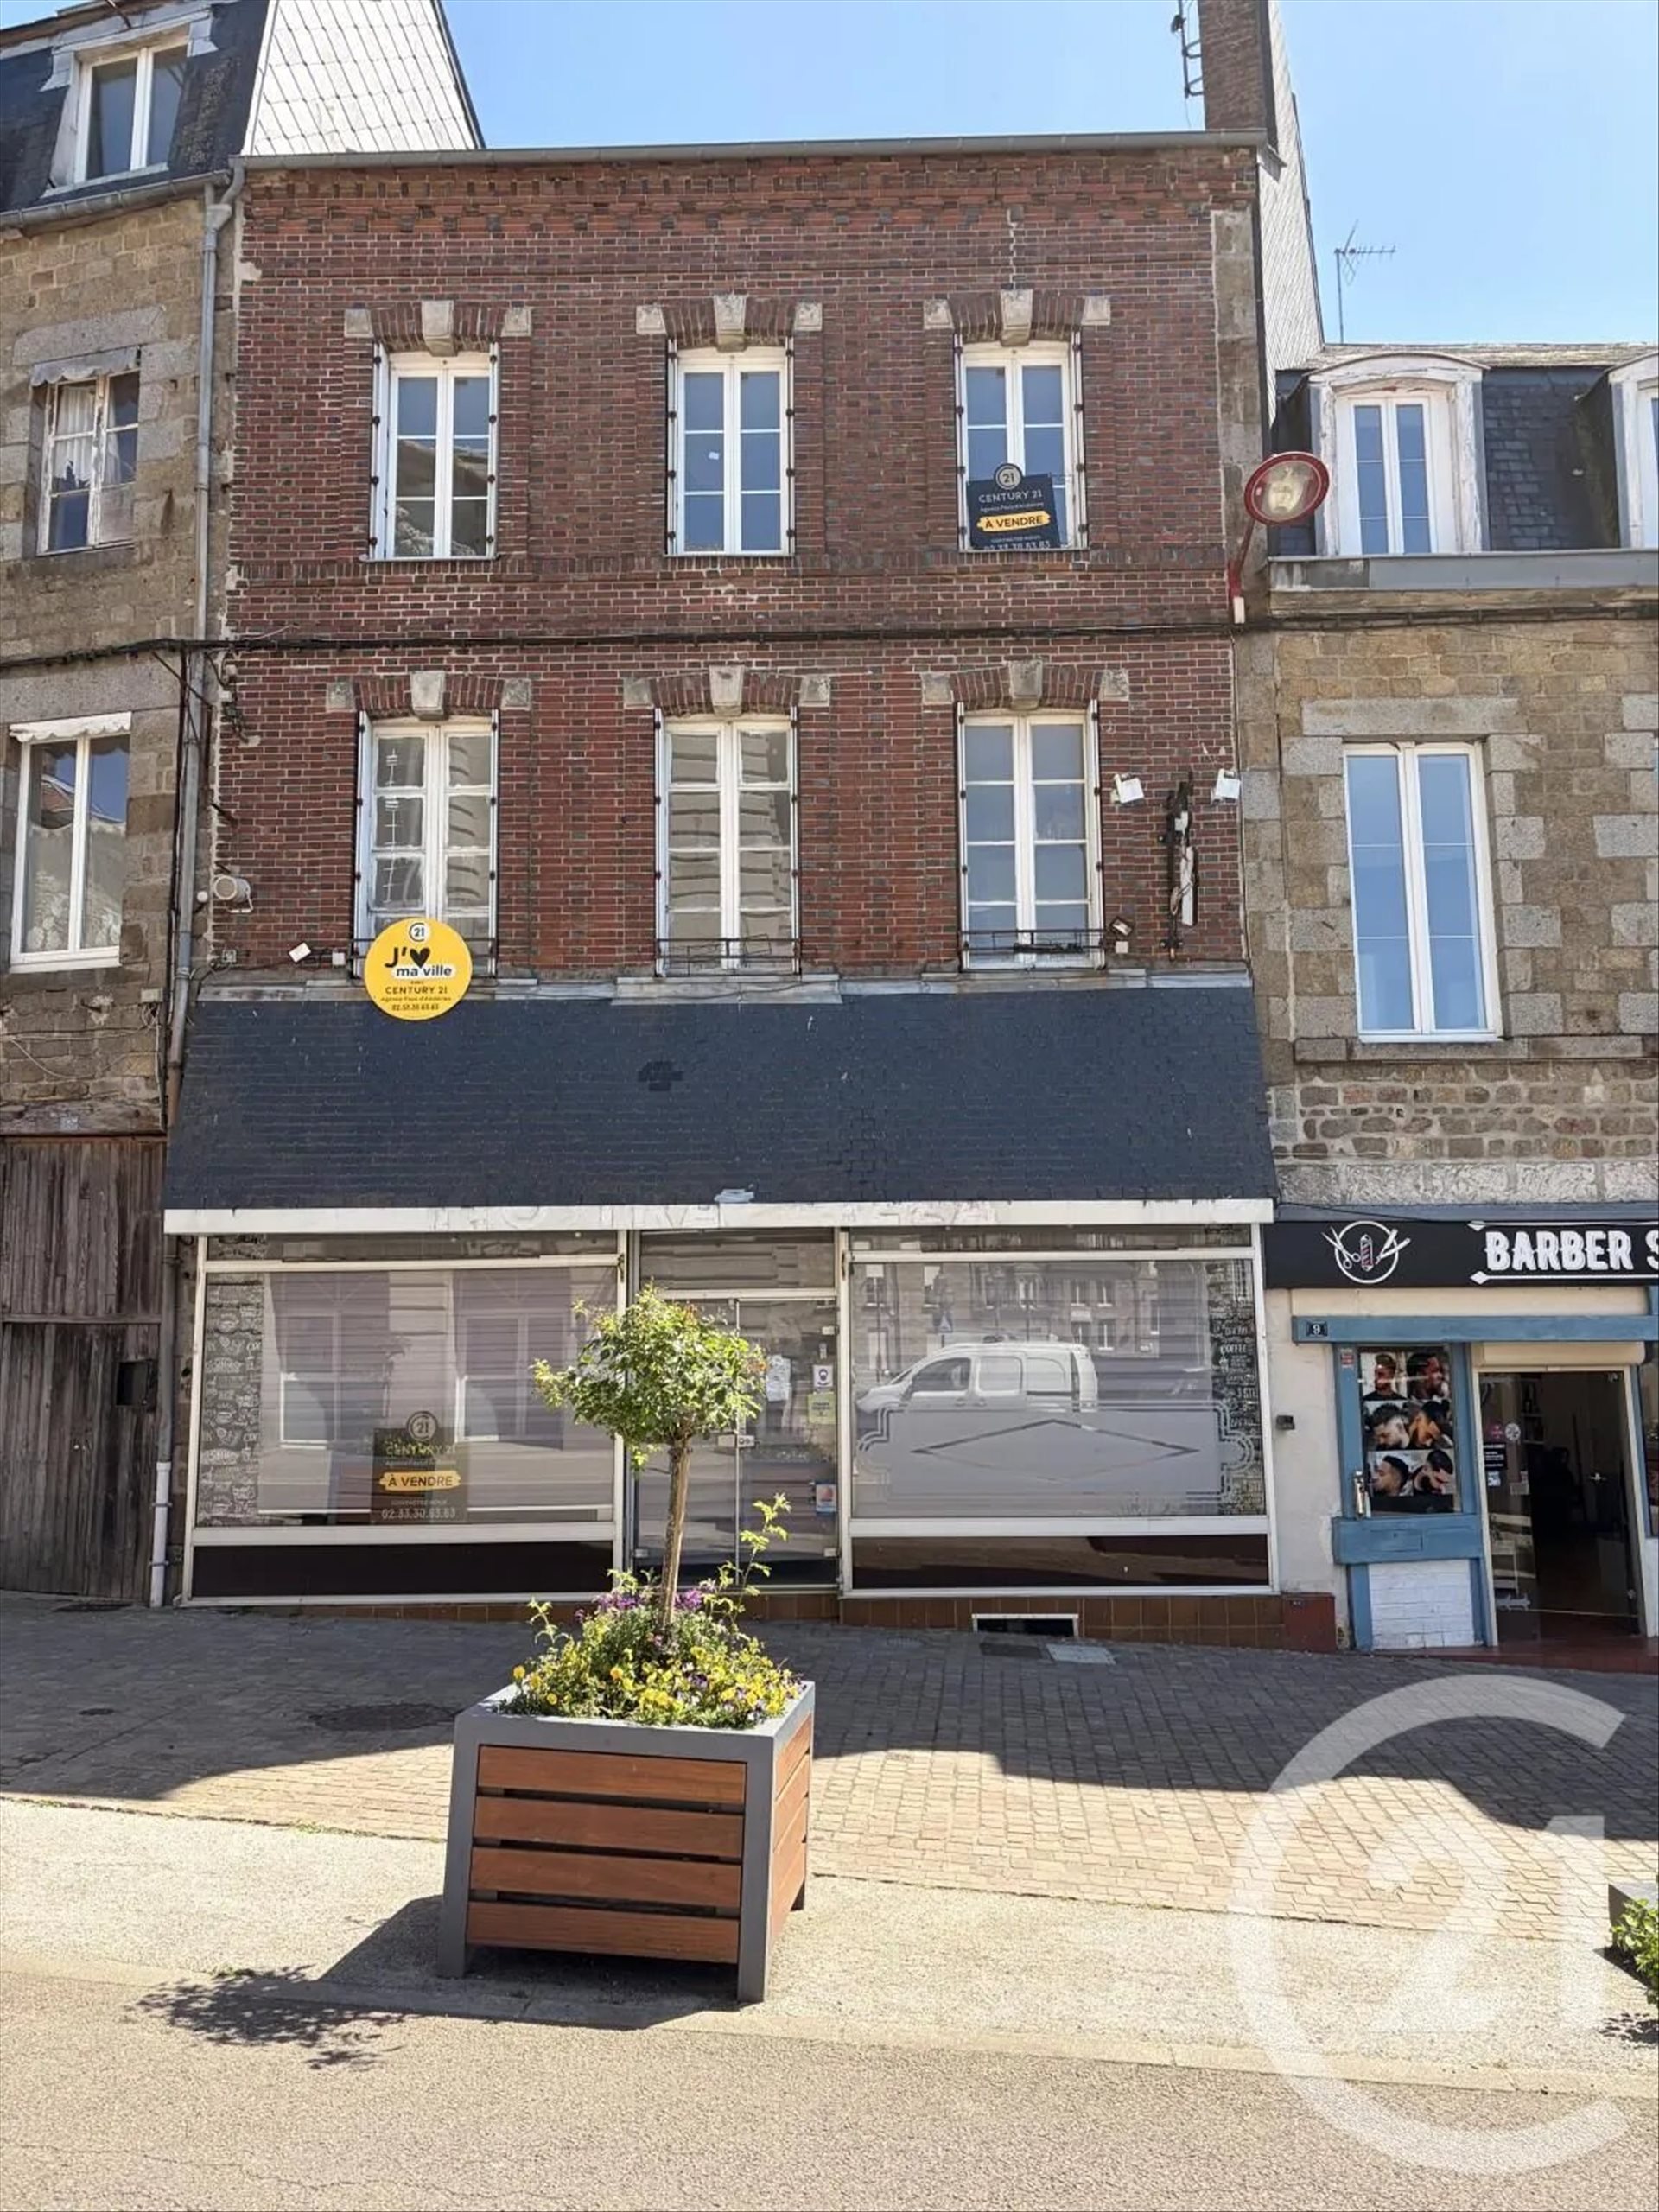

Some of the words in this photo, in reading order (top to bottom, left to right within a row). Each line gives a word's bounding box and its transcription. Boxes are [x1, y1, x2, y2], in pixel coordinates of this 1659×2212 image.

[1002, 473, 1014, 483] 21
[978, 491, 1029, 503] CENTURY
[1032, 489, 1042, 499] 21
[985, 518, 994, 528] À
[996, 515, 1044, 528] VENDRE
[414, 927, 425, 937] 21
[396, 968, 418, 976] ma
[423, 964, 452, 976] ville
[385, 986, 435, 995] CENTURY
[1484, 1230, 1634, 1271] BARBER
[1313, 1324, 1321, 1335] 9
[416, 1421, 429, 1433] 21
[388, 1473, 397, 1486] À
[401, 1476, 453, 1487] VENDRE
